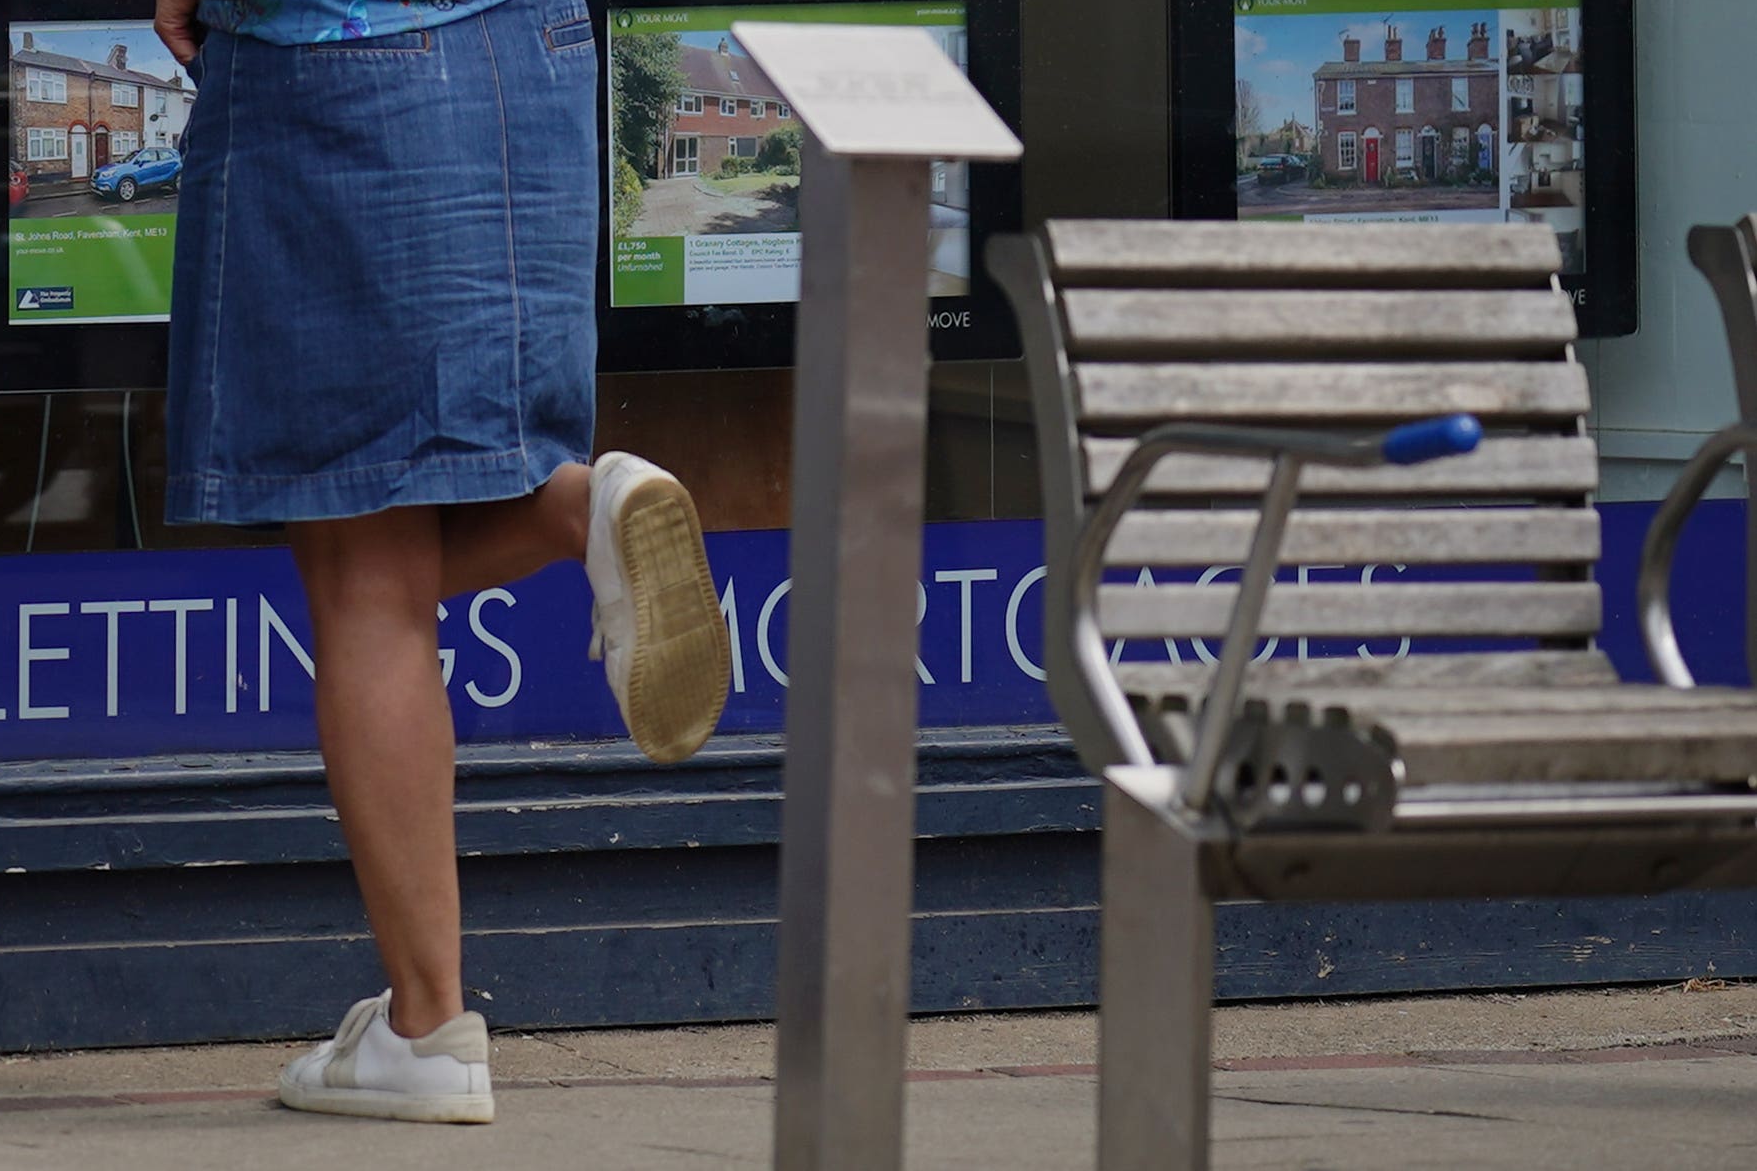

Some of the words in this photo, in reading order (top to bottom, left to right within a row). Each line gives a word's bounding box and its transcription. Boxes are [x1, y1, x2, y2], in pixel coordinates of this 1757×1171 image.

[636, 13, 661, 23] YOUR
[663, 12, 688, 22] MOVE
[145, 228, 167, 237] ME13
[617, 254, 632, 262] per
[633, 252, 661, 260] month
[926, 312, 971, 329] MOVE
